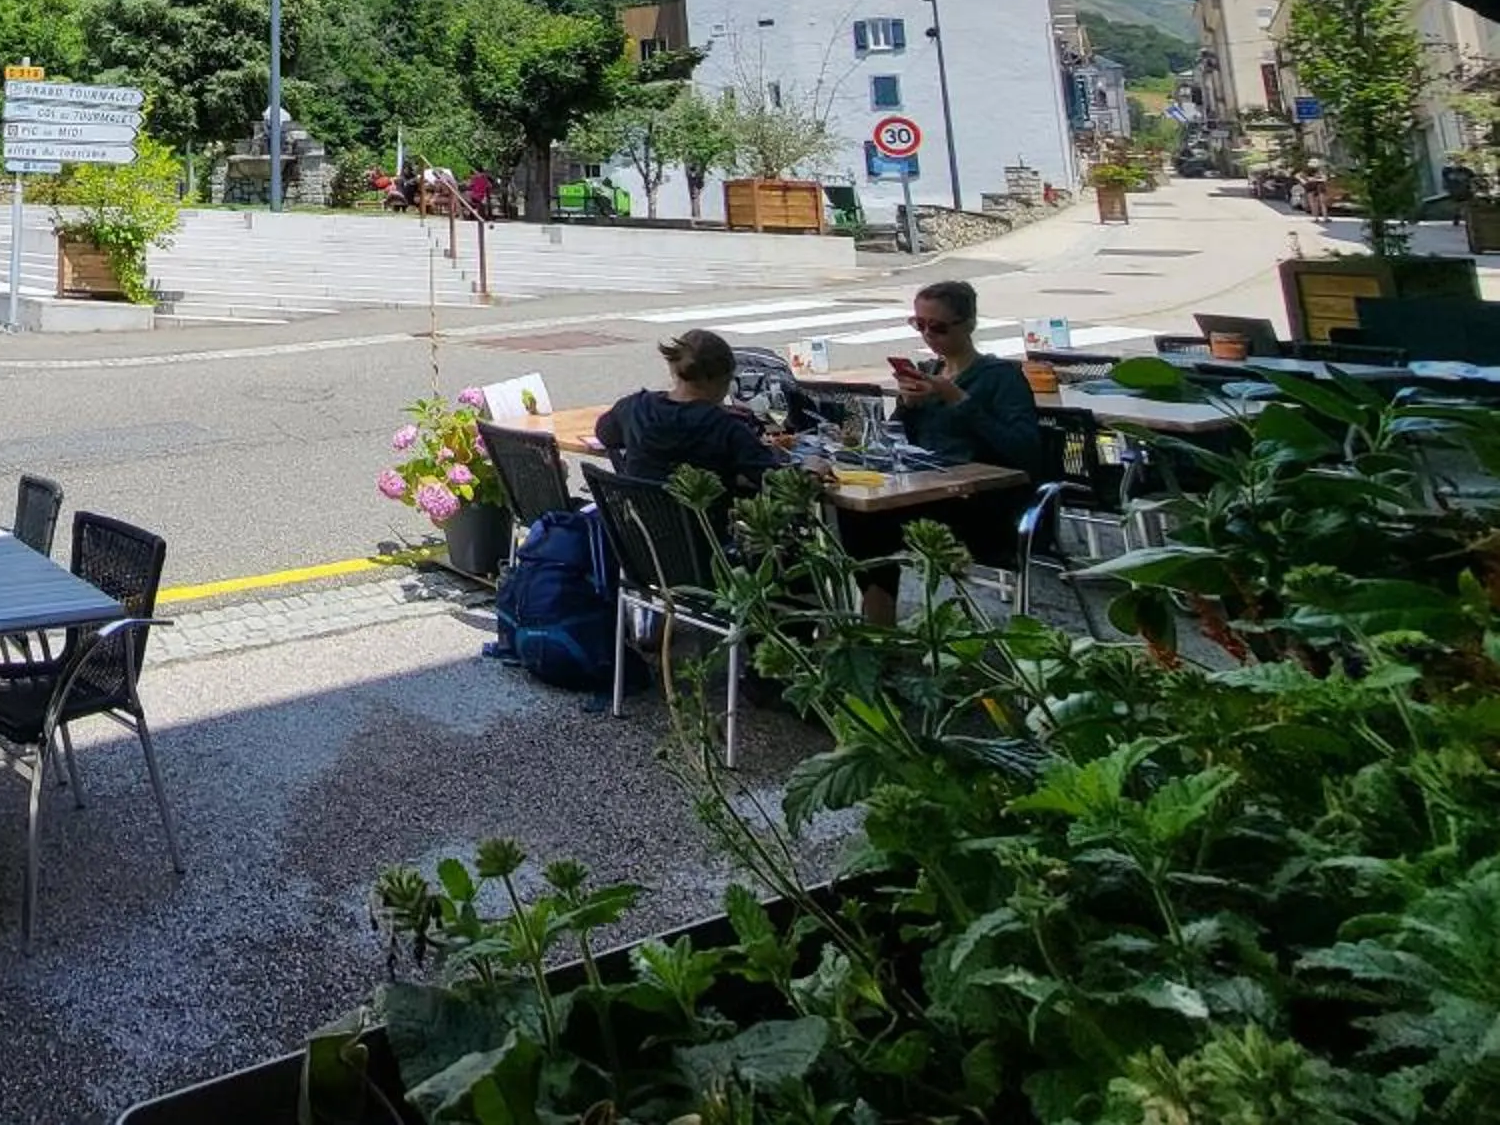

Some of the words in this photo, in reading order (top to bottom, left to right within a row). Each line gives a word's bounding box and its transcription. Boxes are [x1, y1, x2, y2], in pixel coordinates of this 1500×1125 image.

[69, 88, 136, 104] TOURMALET
[37, 108, 56, 119] COL
[73, 110, 134, 124] TOURMALET
[21, 128, 38, 137] PIC
[58, 127, 84, 138] MIDI
[884, 128, 912, 145] 30
[59, 147, 107, 158] tourisme
